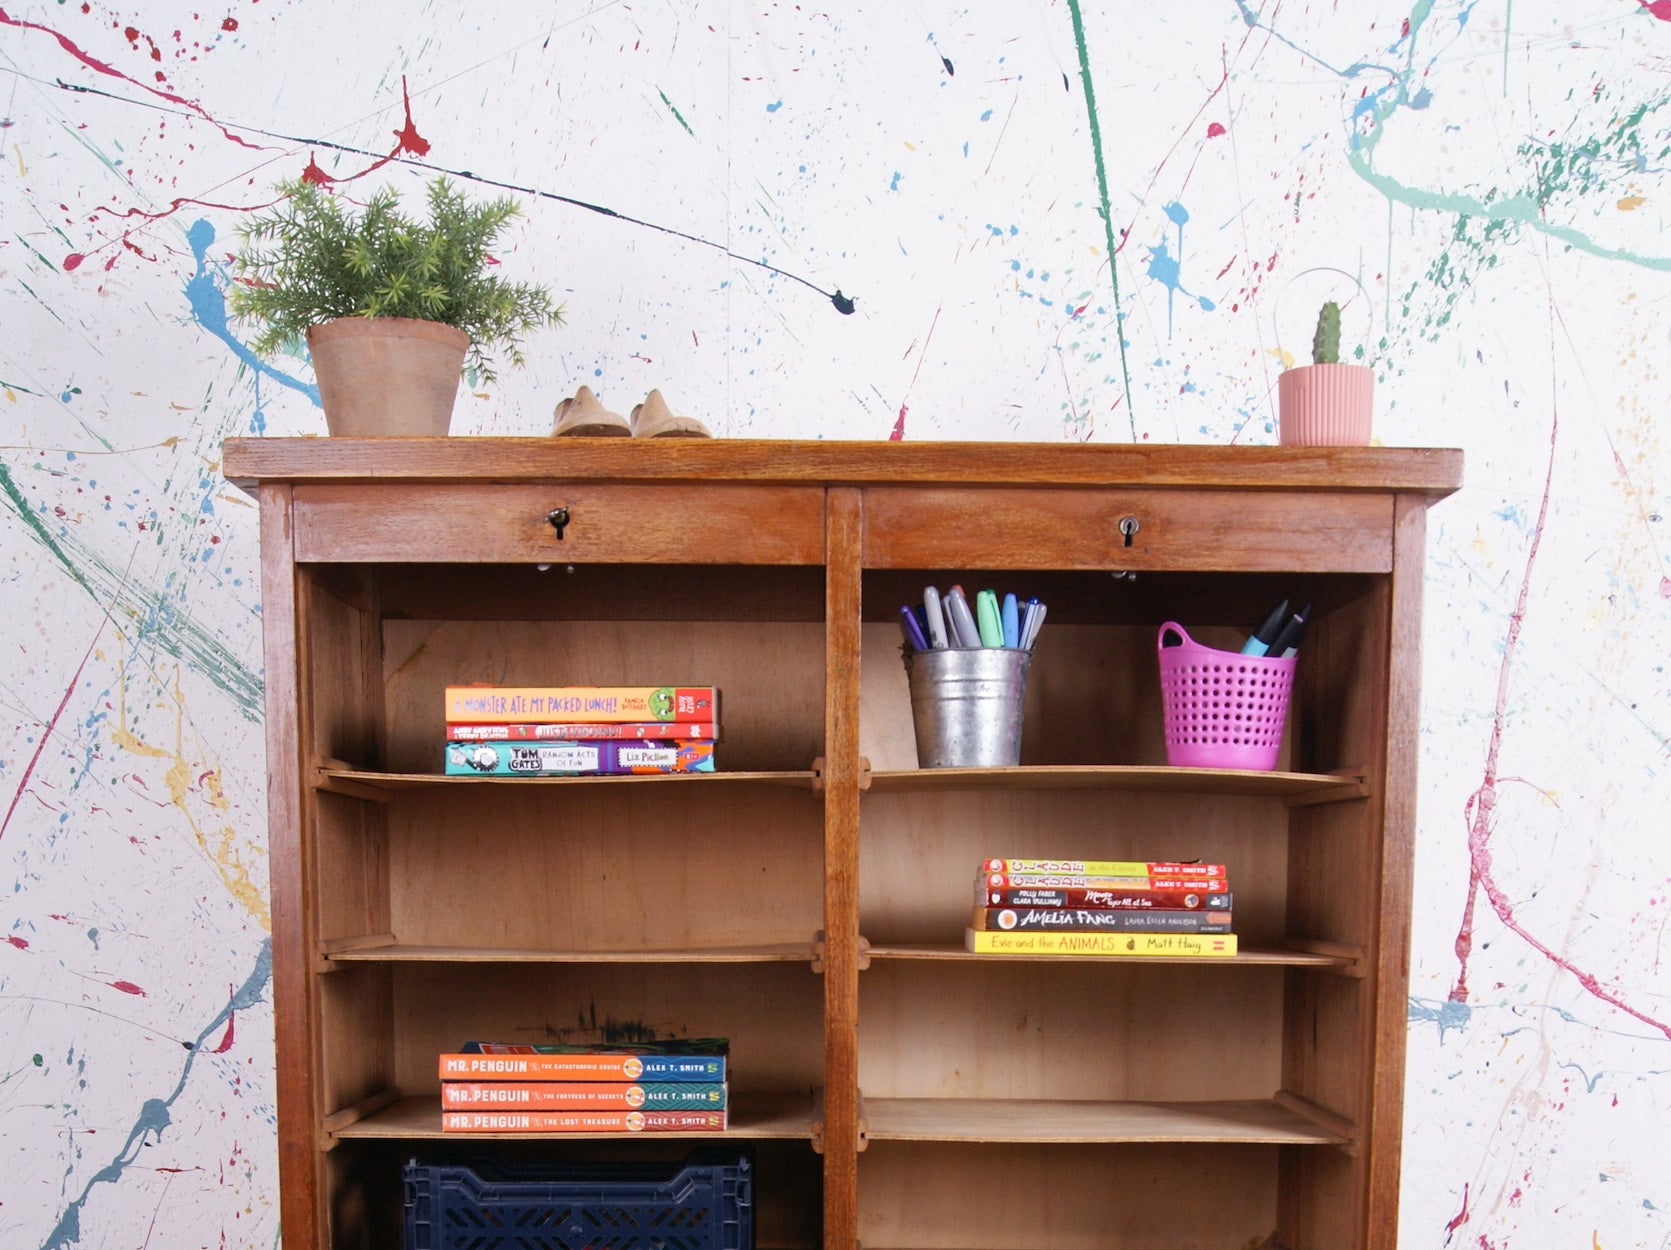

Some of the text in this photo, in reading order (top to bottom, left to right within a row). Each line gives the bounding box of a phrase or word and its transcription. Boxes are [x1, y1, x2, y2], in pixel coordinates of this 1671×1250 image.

[465, 696, 506, 716] MONSTER
[511, 696, 526, 714] ATE
[530, 697, 544, 714] MY
[548, 697, 581, 714] PACKED
[585, 697, 617, 714] LUNCH!
[513, 749, 538, 759] TOM
[577, 750, 596, 758] ACTS
[511, 760, 541, 770] GATES
[1012, 861, 1084, 873] CLAUDE
[1013, 876, 1085, 887] CLAUDE
[1077, 911, 1116, 926] FANG
[991, 936, 1013, 948] Evie
[1015, 938, 1034, 948] and
[1038, 937, 1054, 948] the
[1058, 937, 1115, 951] ANIMALS
[1147, 938, 1172, 949] Matt
[1177, 937, 1202, 954] Haig
[448, 1060, 469, 1072] MR.
[472, 1060, 527, 1072] PENGUIN
[646, 1064, 666, 1072] ALEX
[680, 1064, 704, 1072] SMITH
[450, 1090, 472, 1102] MR.
[474, 1090, 529, 1102] PENGUIN
[648, 1092, 668, 1100] ALEX
[450, 1116, 472, 1128] MR.
[474, 1116, 529, 1128] PENGUIN
[583, 1118, 620, 1126] TREASURE
[647, 1117, 667, 1125] ALEX
[681, 1117, 706, 1125] SMITH
